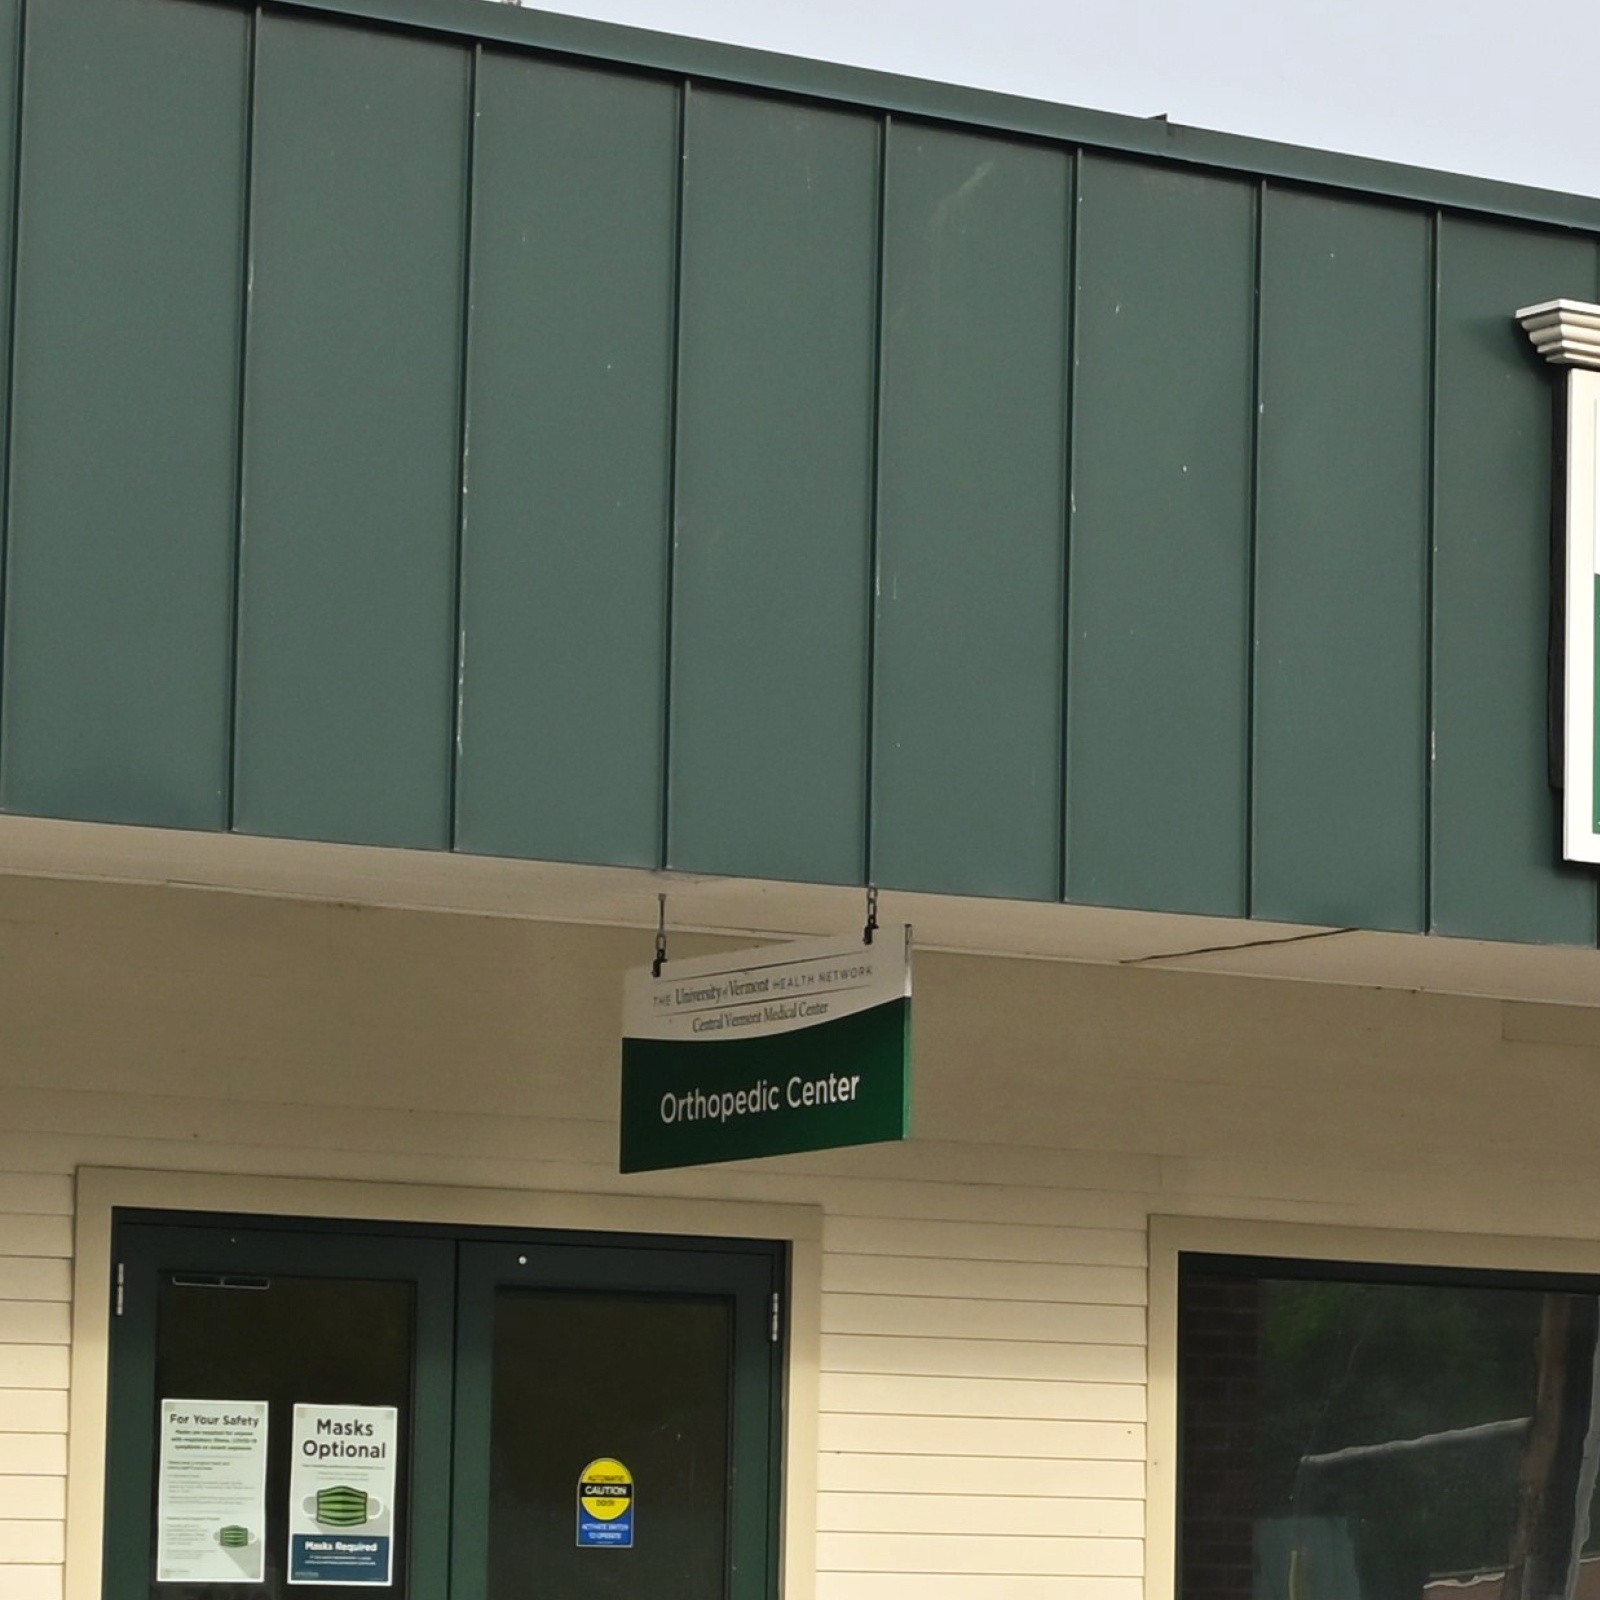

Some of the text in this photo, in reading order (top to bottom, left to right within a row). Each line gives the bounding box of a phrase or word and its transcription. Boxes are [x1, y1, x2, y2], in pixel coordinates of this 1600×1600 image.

[675, 984, 721, 1005] University
[728, 977, 769, 997] Vermont
[773, 975, 814, 990] HEALTH
[819, 965, 873, 982] NETWORK
[693, 1002, 829, 1033] Central Vermont Medical Center
[660, 1073, 860, 1123] Orthopedic Center
[170, 1413, 259, 1428] For Your Safety
[317, 1418, 373, 1436] Masks
[303, 1440, 386, 1460] Optional
[585, 1486, 627, 1495] CAUTION
[304, 1541, 378, 1553] Masks Required
